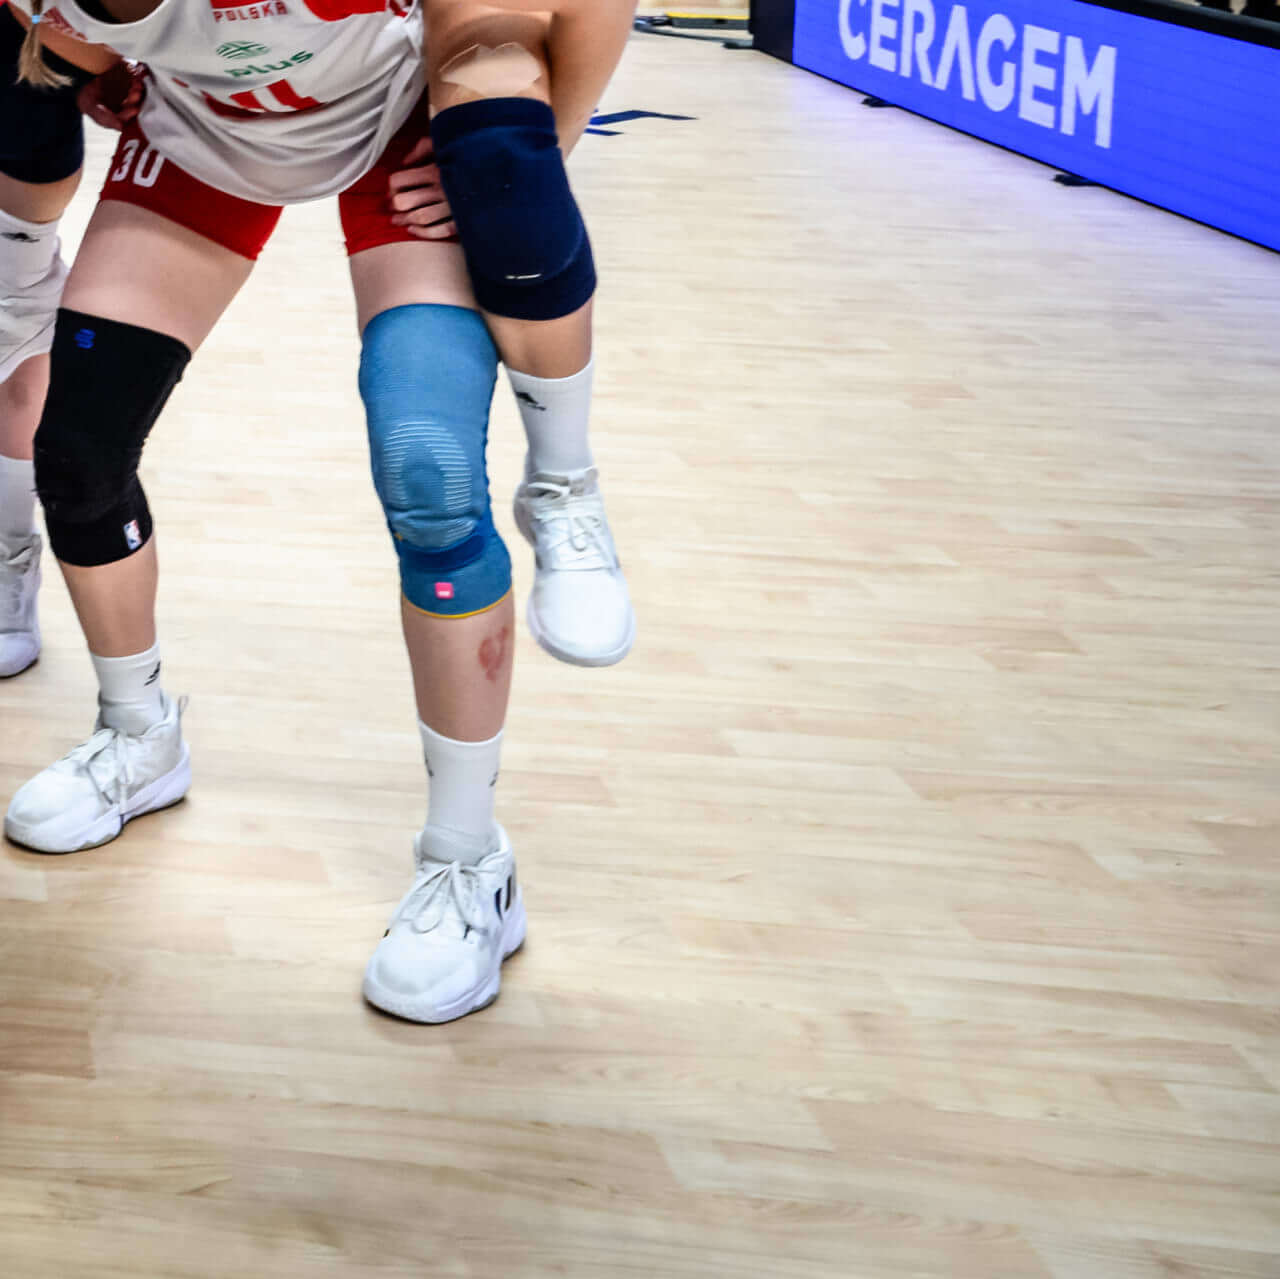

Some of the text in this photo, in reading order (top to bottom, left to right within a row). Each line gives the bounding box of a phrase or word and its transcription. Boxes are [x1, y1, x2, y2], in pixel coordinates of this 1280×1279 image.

[212, 0, 289, 24] POLSKA
[224, 49, 315, 79] plus
[111, 136, 166, 190] 30
